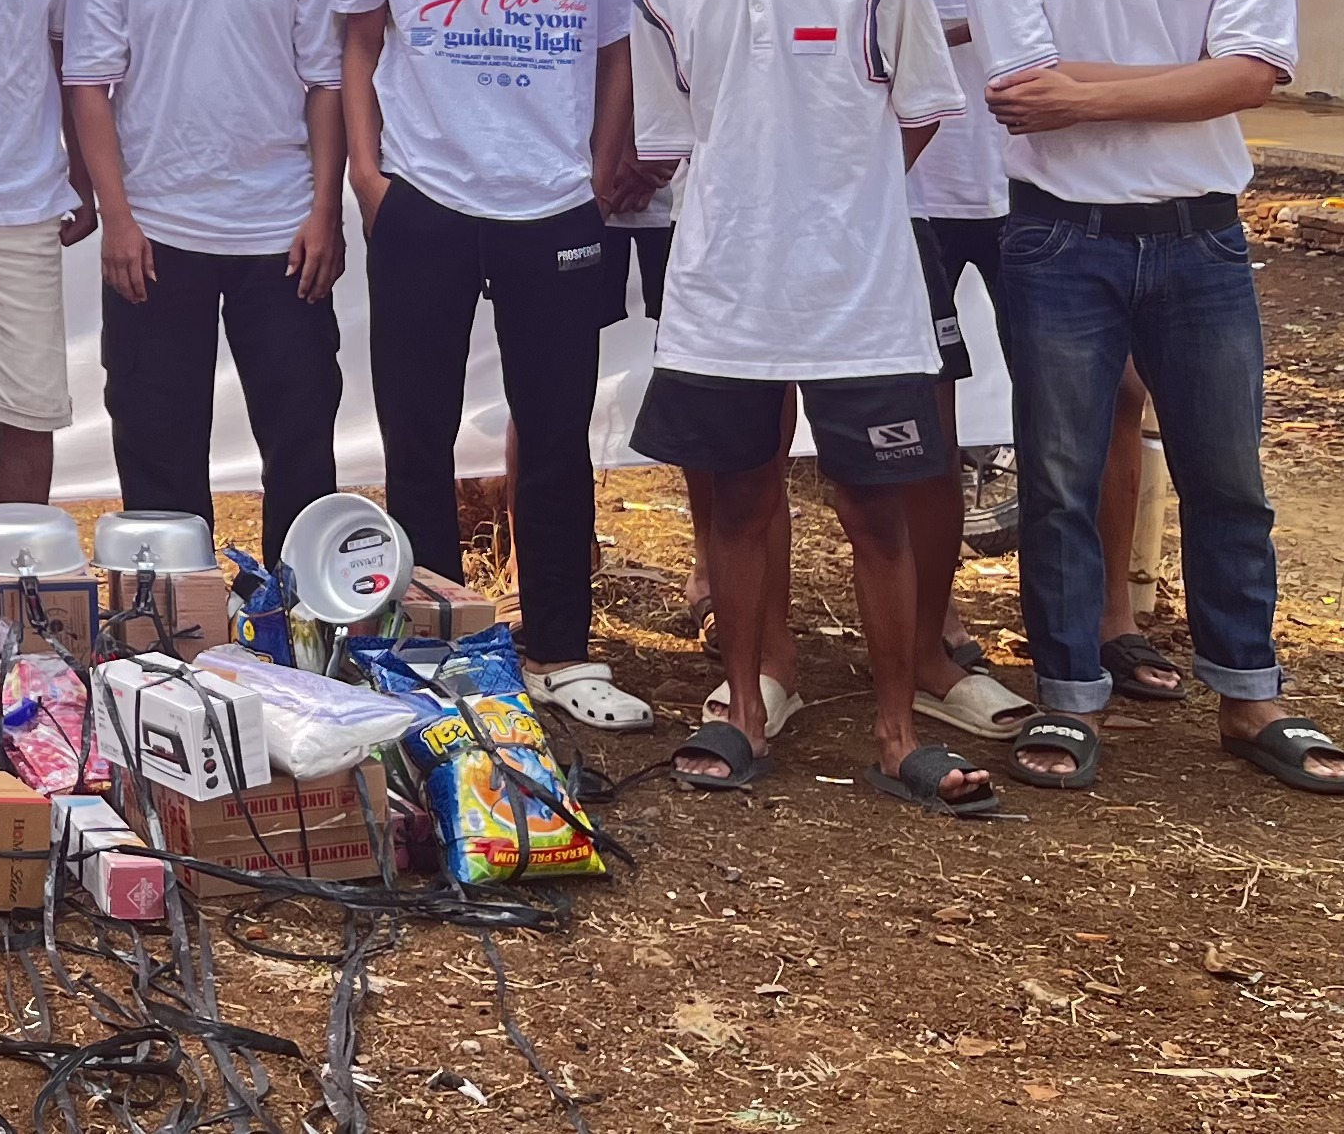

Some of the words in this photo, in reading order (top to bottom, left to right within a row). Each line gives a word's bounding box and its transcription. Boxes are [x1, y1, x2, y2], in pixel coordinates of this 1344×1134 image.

[504, 10, 532, 27] be
[533, 14, 587, 30] your
[443, 27, 532, 53] guiding
[534, 27, 582, 55] light
[875, 445, 924, 461] SPORTS
[421, 715, 508, 757] Lkal
[493, 851, 552, 865] PREIUM
[554, 845, 590, 863] BERAS
